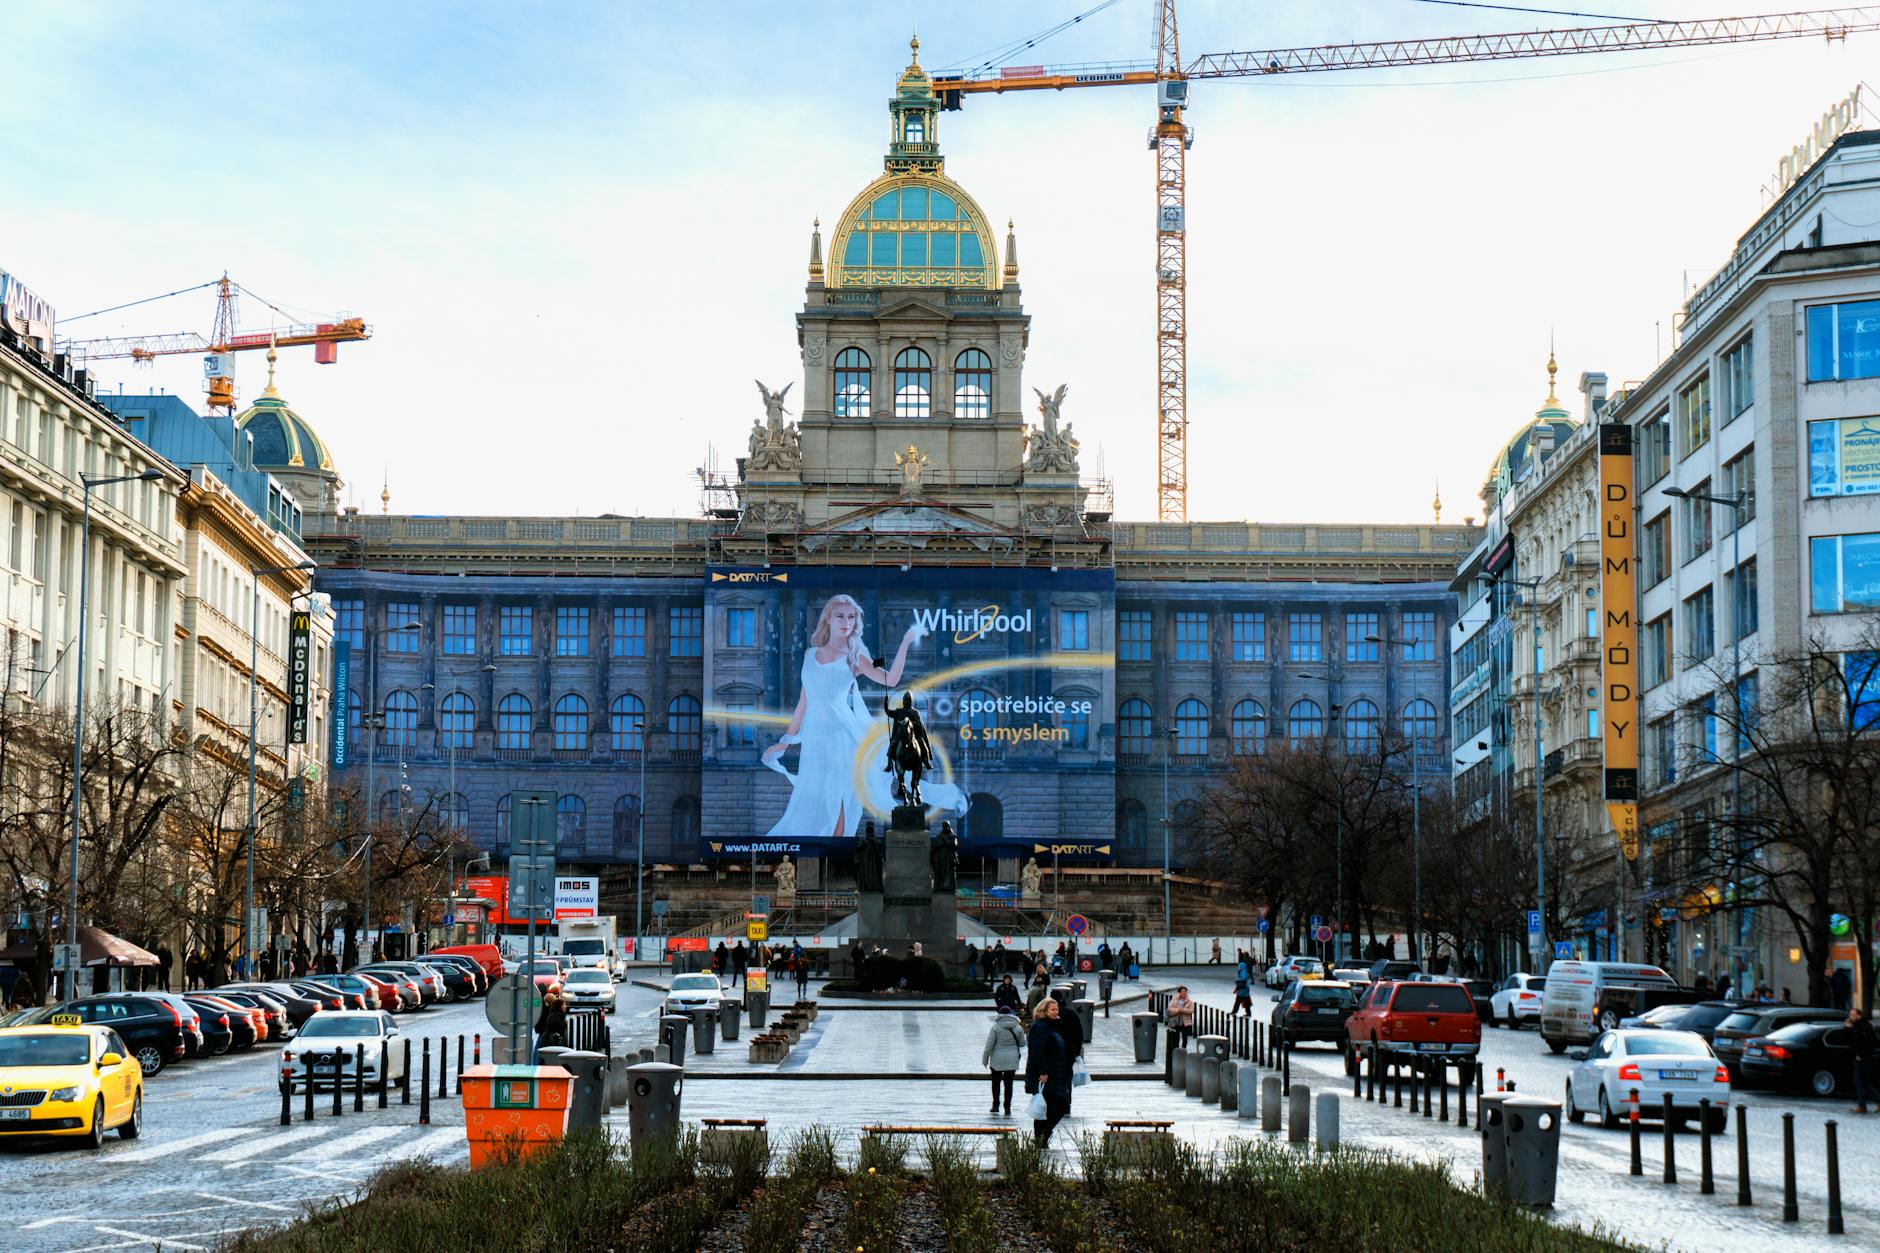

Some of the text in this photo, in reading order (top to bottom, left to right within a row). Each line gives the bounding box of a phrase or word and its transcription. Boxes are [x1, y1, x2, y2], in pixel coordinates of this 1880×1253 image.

[1076, 74, 1123, 82] LIEBHERR
[729, 573, 773, 582] DATART
[1607, 484, 1630, 739] DŮM MÓDY
[913, 608, 1032, 639] Whirlpool
[293, 636, 307, 742] McDonald's
[335, 662, 346, 764] Occidental Praha Wilson
[960, 696, 1092, 717] spotřebiče se
[959, 723, 1070, 744] 6. smyslem
[725, 843, 801, 852] www.DATART.cz
[1051, 845, 1095, 854] DATART
[560, 881, 590, 890] IMOS
[55, 1015, 79, 1024] TAXI
